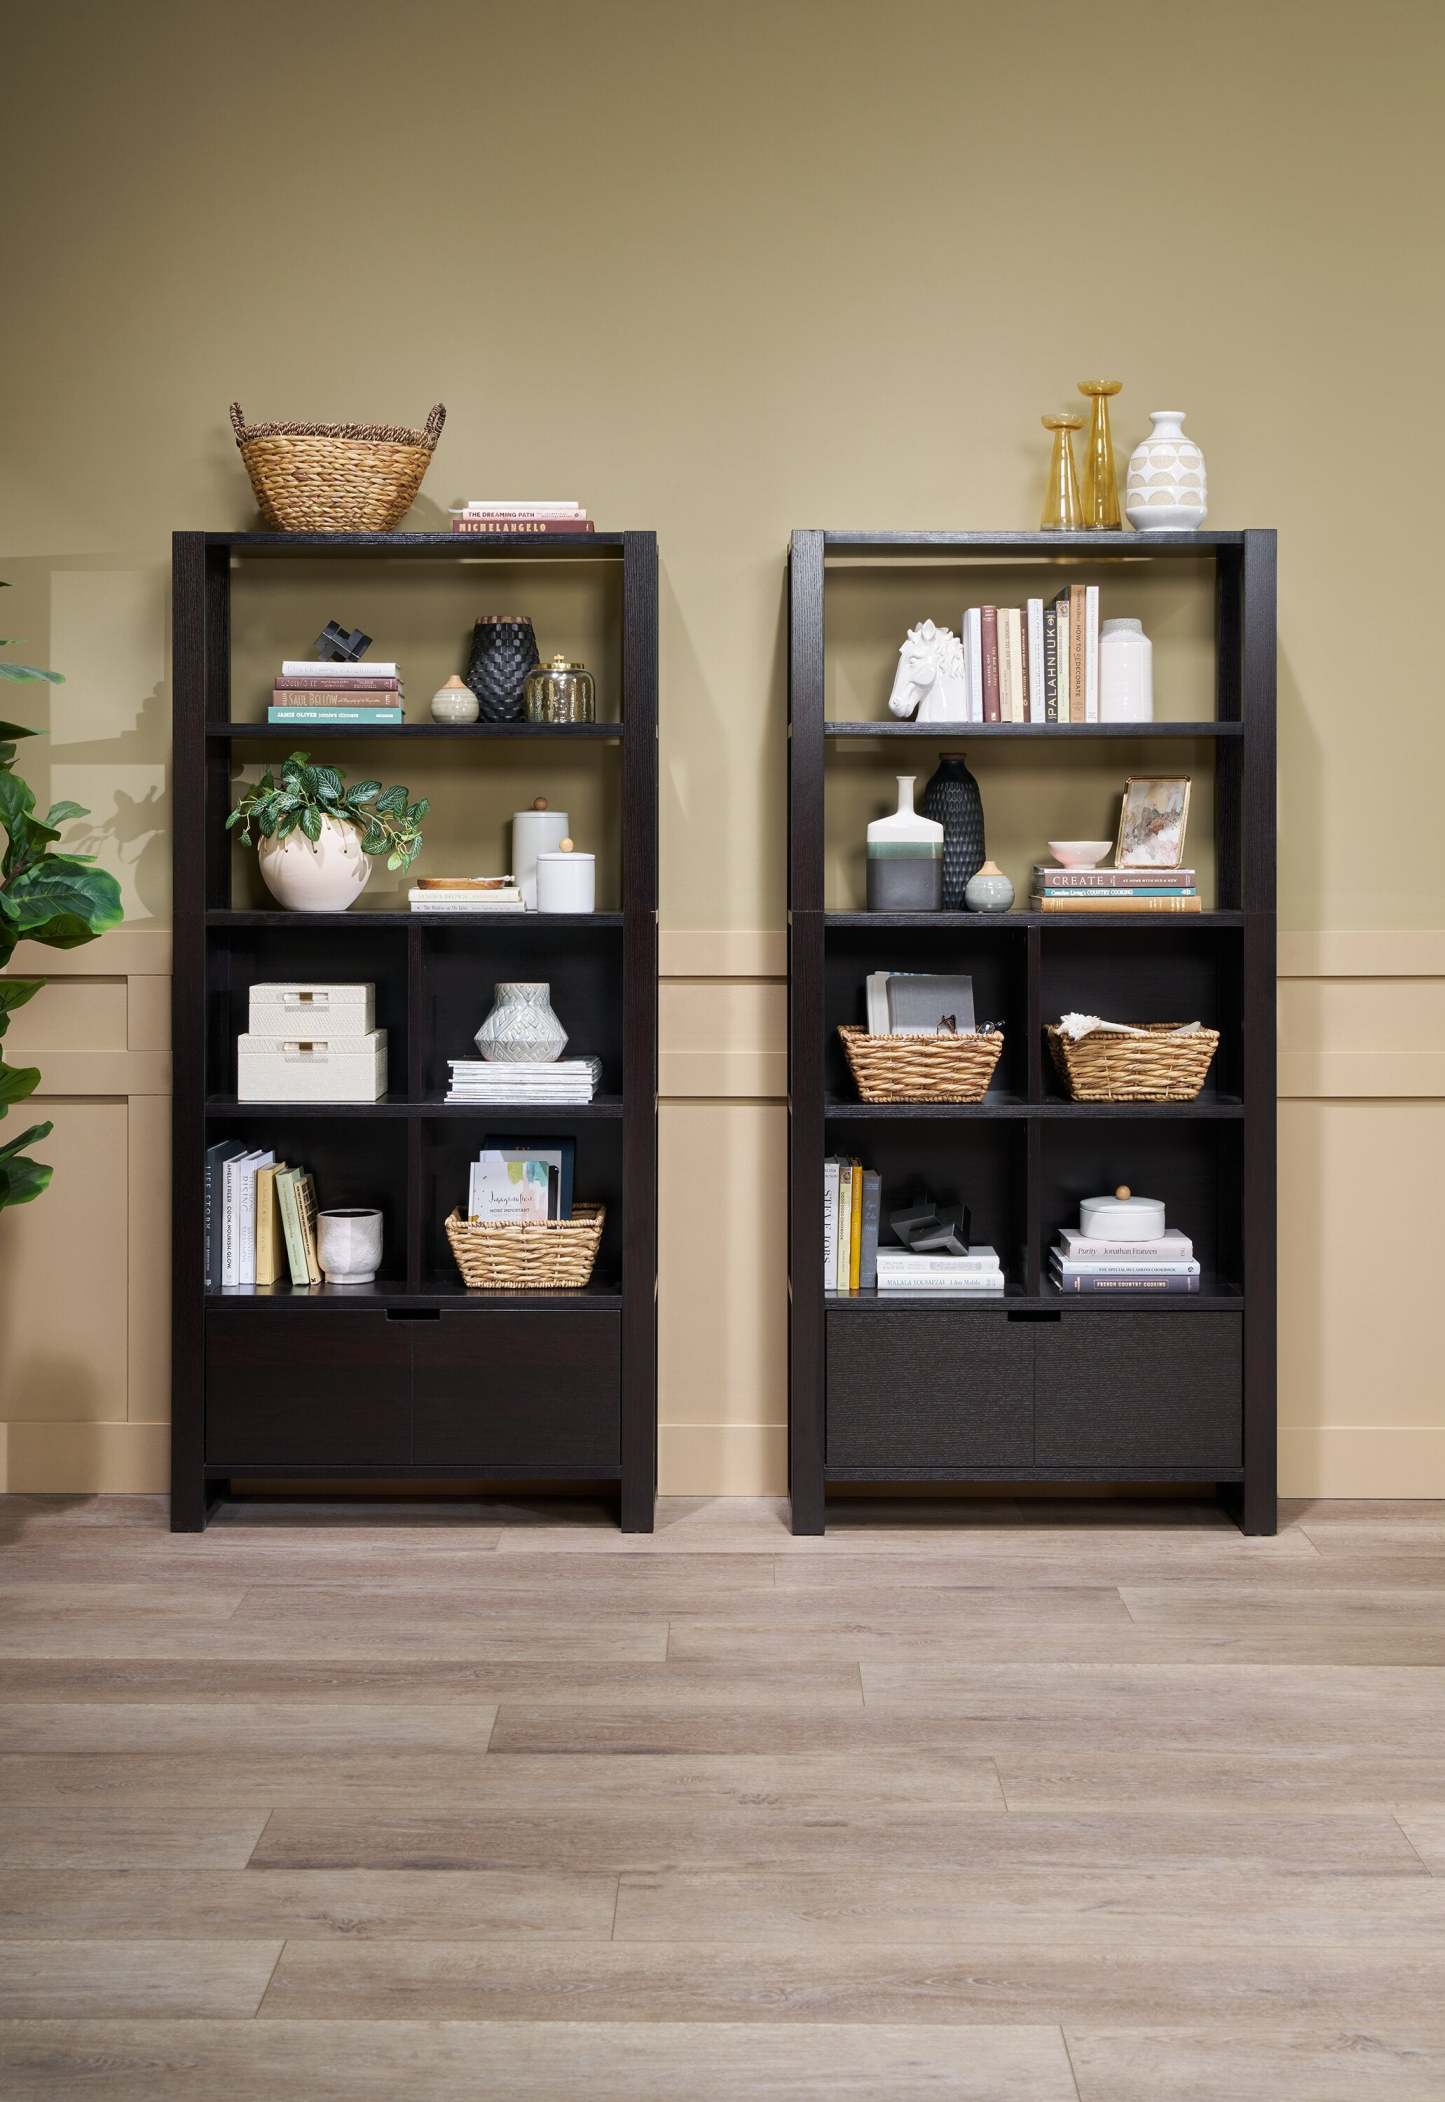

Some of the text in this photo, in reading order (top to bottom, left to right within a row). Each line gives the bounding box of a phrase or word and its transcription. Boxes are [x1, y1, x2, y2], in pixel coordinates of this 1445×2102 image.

[459, 523, 546, 532] MICHELANGELO
[1075, 643, 1081, 651] TO
[1047, 628, 1057, 716] PALAHNIUK
[1052, 876, 1104, 886] CREATE
[824, 1189, 832, 1263] STEVE JOBS
[1078, 1247, 1096, 1256] Purity
[1103, 1247, 1157, 1255] Jonathan Franzen
